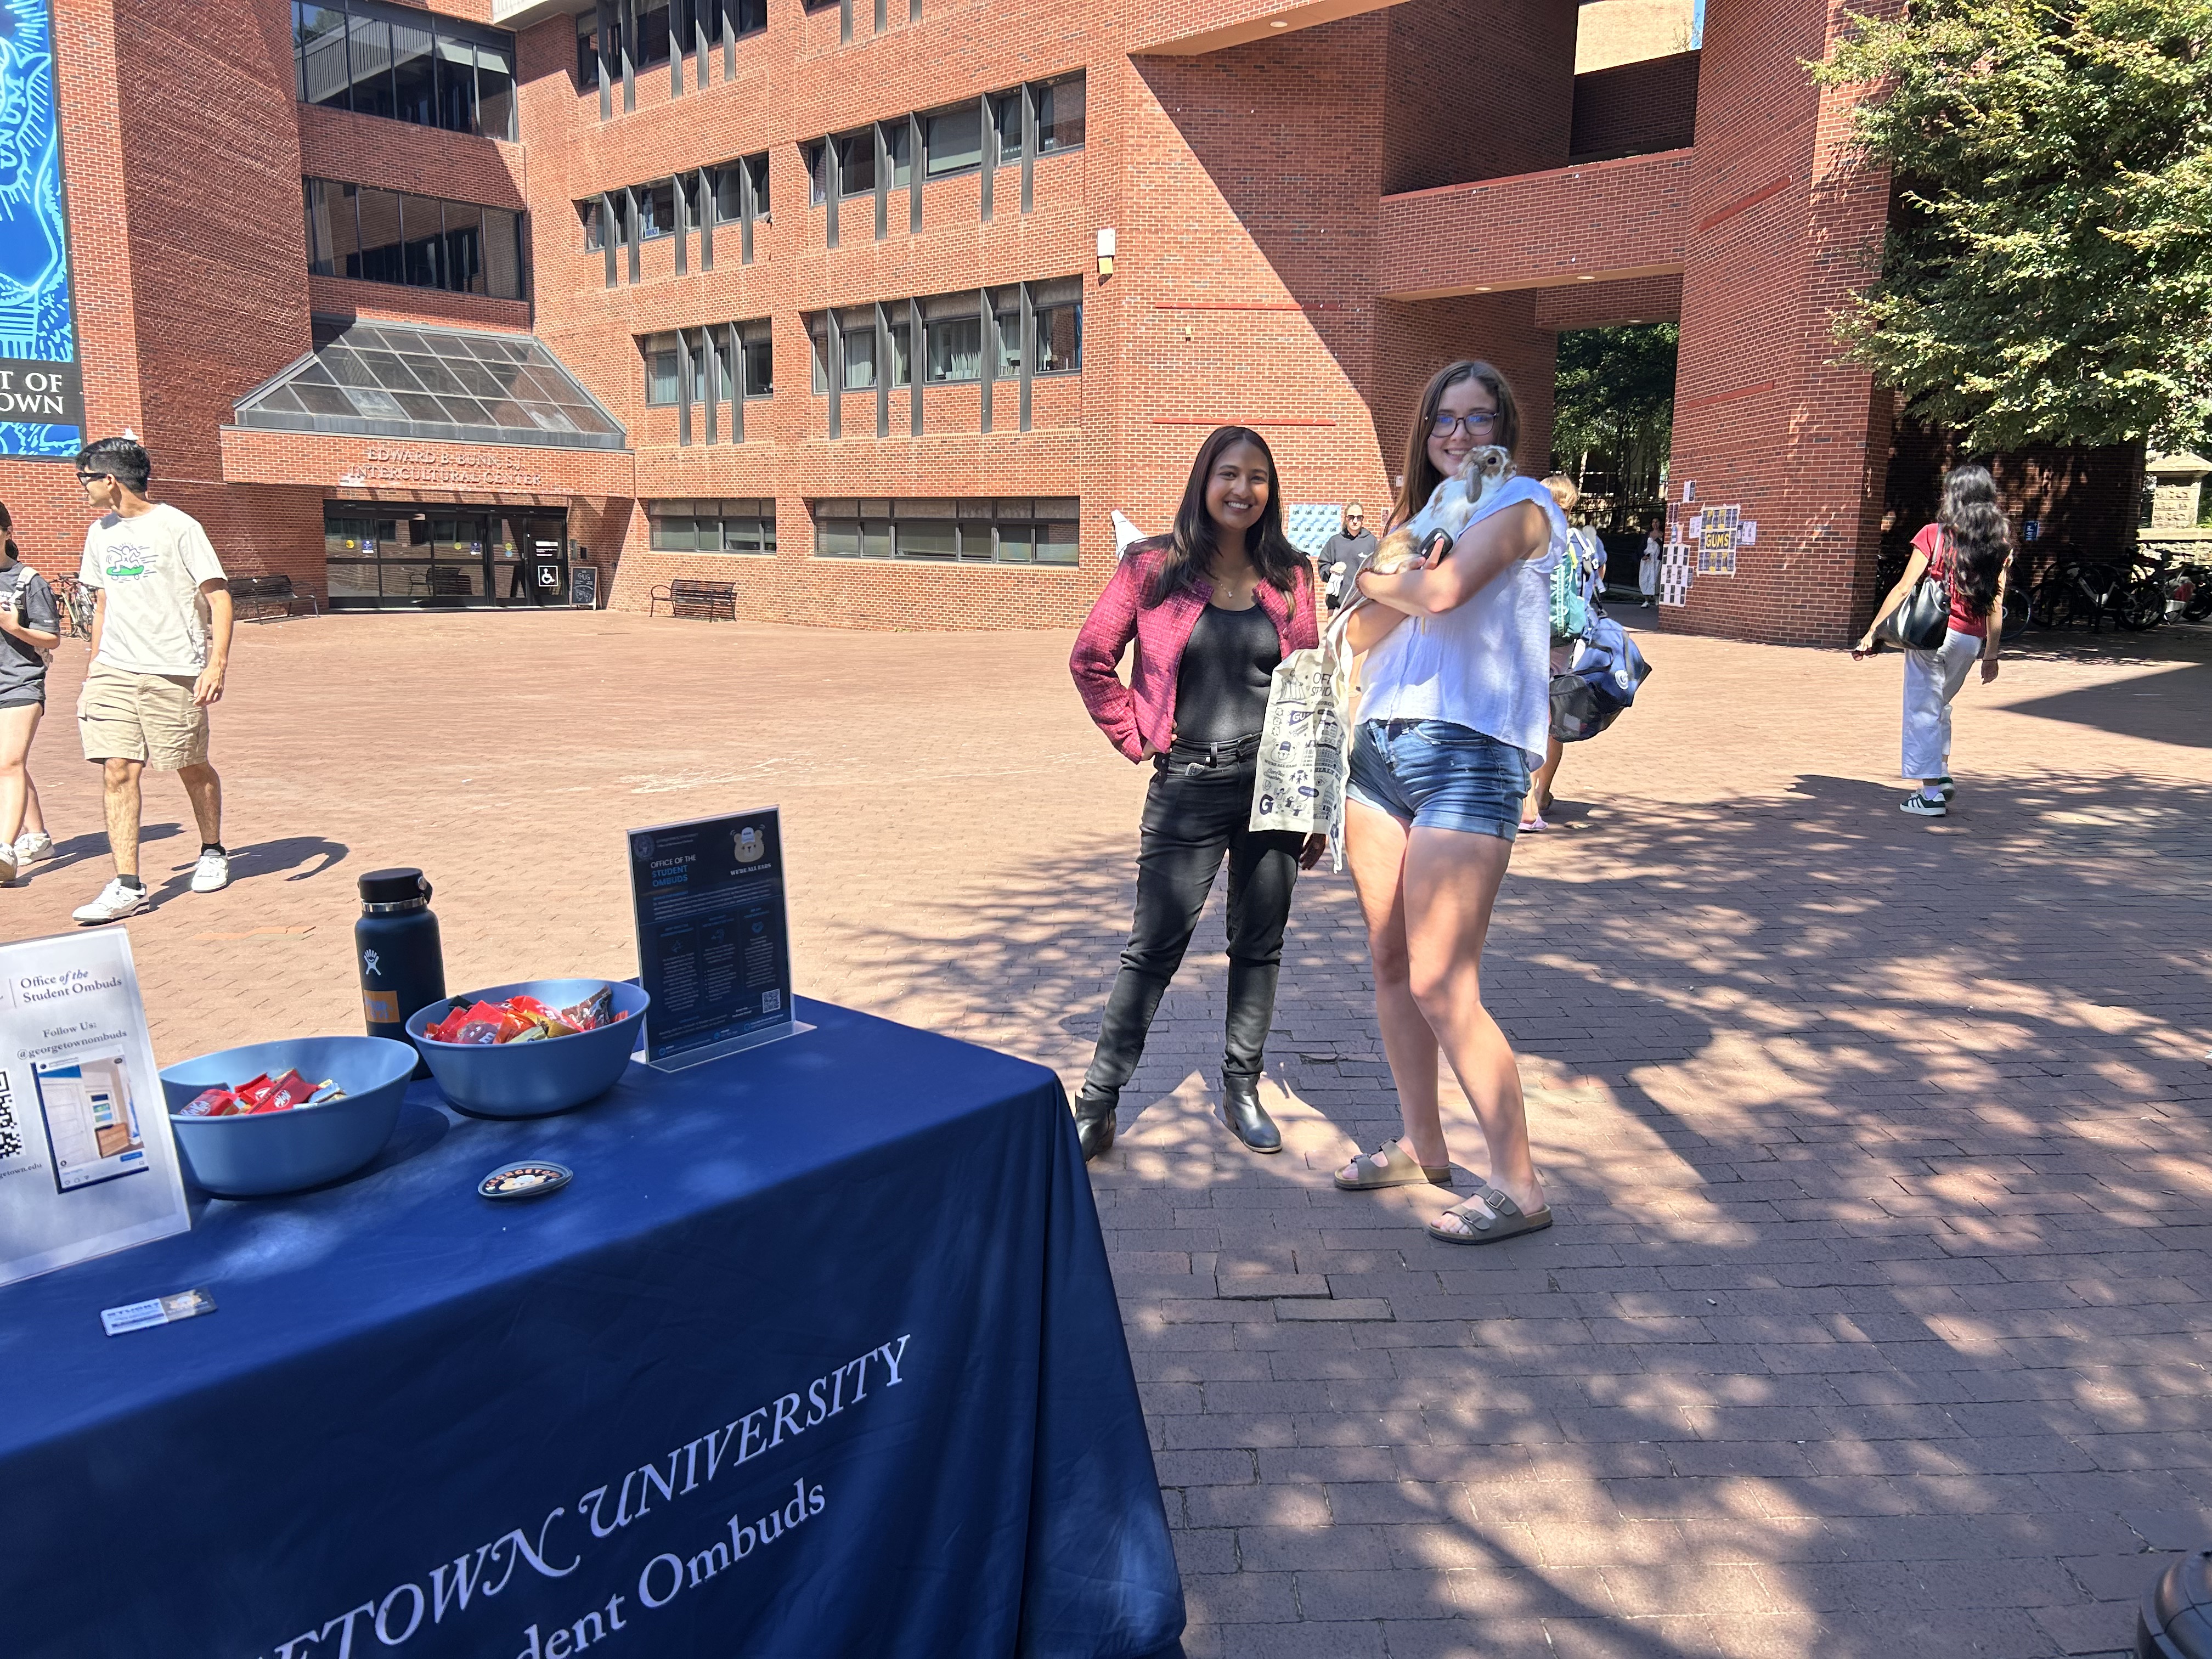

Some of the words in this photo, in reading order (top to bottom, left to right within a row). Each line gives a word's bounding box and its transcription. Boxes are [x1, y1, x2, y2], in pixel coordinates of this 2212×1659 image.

[25, 373, 63, 393] OF
[0, 392, 64, 415] OWN
[368, 449, 436, 464] EDWARD
[441, 453, 453, 464] B.
[458, 454, 502, 470] BUNN,
[507, 456, 526, 471] S.J.
[349, 466, 481, 483] INTERCULTURAL
[485, 472, 543, 486] CENTER
[1706, 533, 1729, 548] GUMS
[1292, 712, 1306, 721] GU
[651, 859, 673, 868] OFFICE
[652, 865, 688, 878] STUDENT
[652, 874, 688, 887] OMBUDS
[20, 976, 56, 988] Office
[59, 970, 71, 985] of
[72, 969, 88, 979] the
[22, 988, 70, 1003] Student
[72, 977, 122, 994] Ombuds
[42, 1026, 77, 1038] Follow
[79, 1022, 97, 1030] Us:
[17, 1030, 127, 1060] @georgetownombuds
[579, 1334, 911, 1537] UNIVERSITY
[639, 1477, 825, 1608] Ombuds
